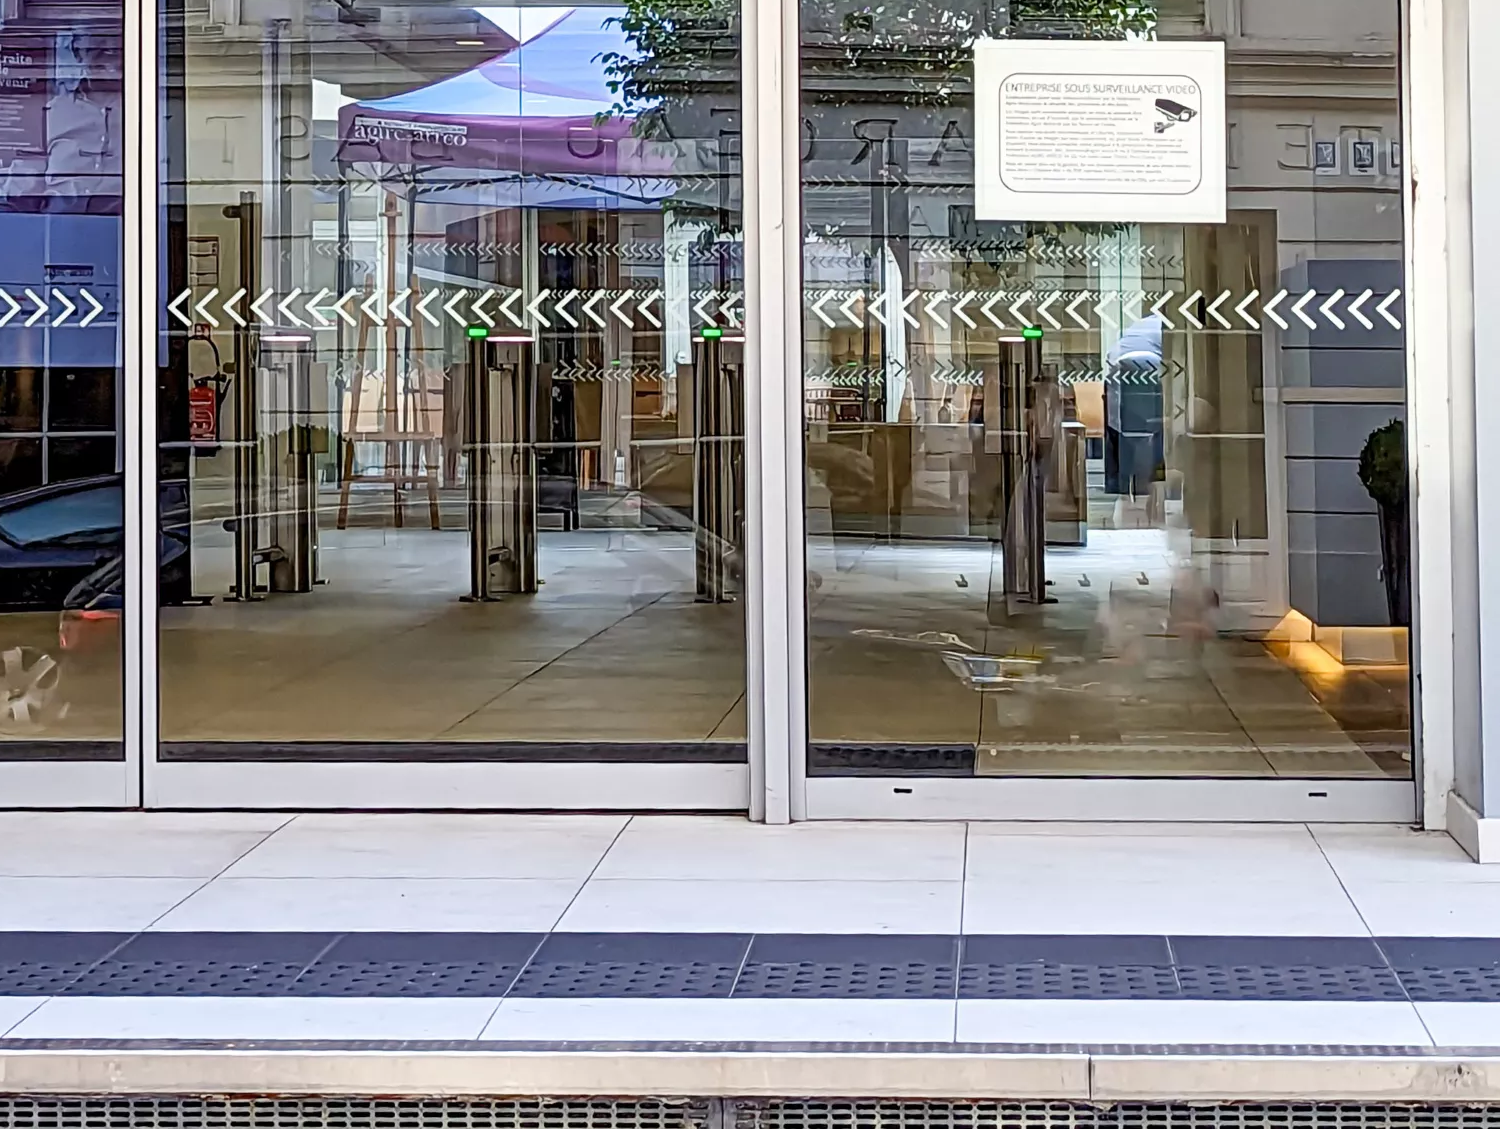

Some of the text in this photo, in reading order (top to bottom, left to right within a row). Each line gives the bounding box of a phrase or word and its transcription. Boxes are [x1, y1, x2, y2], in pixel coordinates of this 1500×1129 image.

[1005, 82, 1062, 93] ENTREPRISE
[1064, 83, 1092, 93] SOUS
[1093, 83, 1164, 94] SURVEILLANCE
